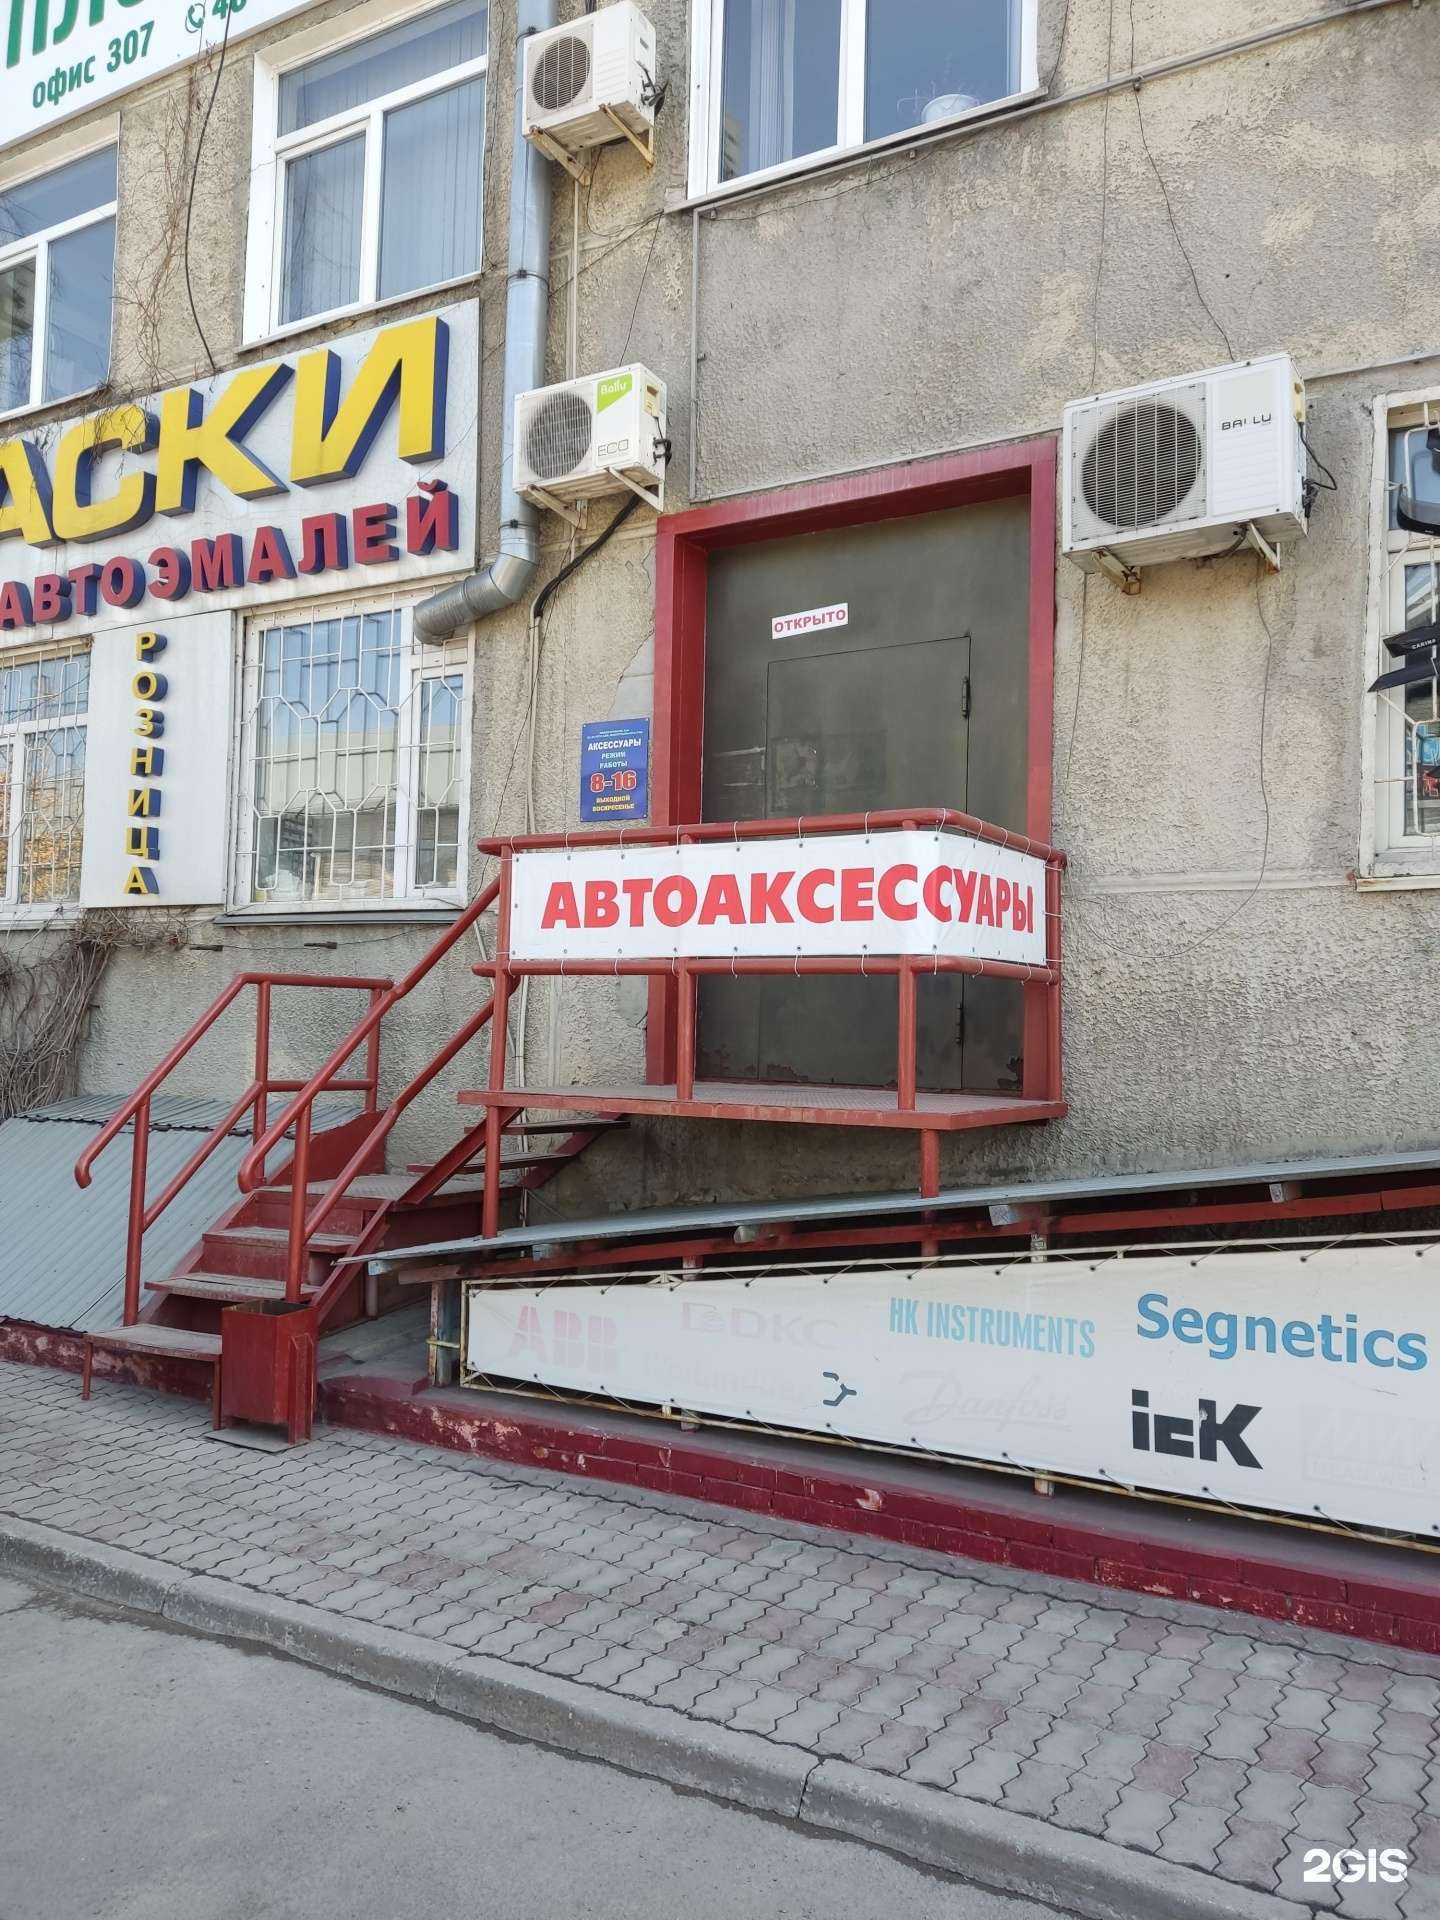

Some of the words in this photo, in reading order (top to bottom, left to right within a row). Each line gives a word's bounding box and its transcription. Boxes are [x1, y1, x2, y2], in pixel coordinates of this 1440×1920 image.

[32, 56, 96, 109] офис
[106, 20, 155, 73] 307
[598, 439, 629, 456] ECO
[0, 479, 459, 631] АВТОЭМАЛЕЙ
[774, 609, 846, 633] ОТКРЫТО
[123, 631, 168, 895] РОЗНИЦА
[587, 738, 642, 751] АКСЕССУАРЫ
[599, 760, 628, 769] РАБОТЫ
[601, 751, 626, 760] РЕЖИМ
[590, 769, 637, 793] 8-16
[540, 864, 1035, 934] АВТОАКСЕССУАРЫ
[889, 1297, 920, 1336] HK
[927, 1301, 1096, 1359] INSTRUMENTS
[1136, 1292, 1428, 1371] Segnetics
